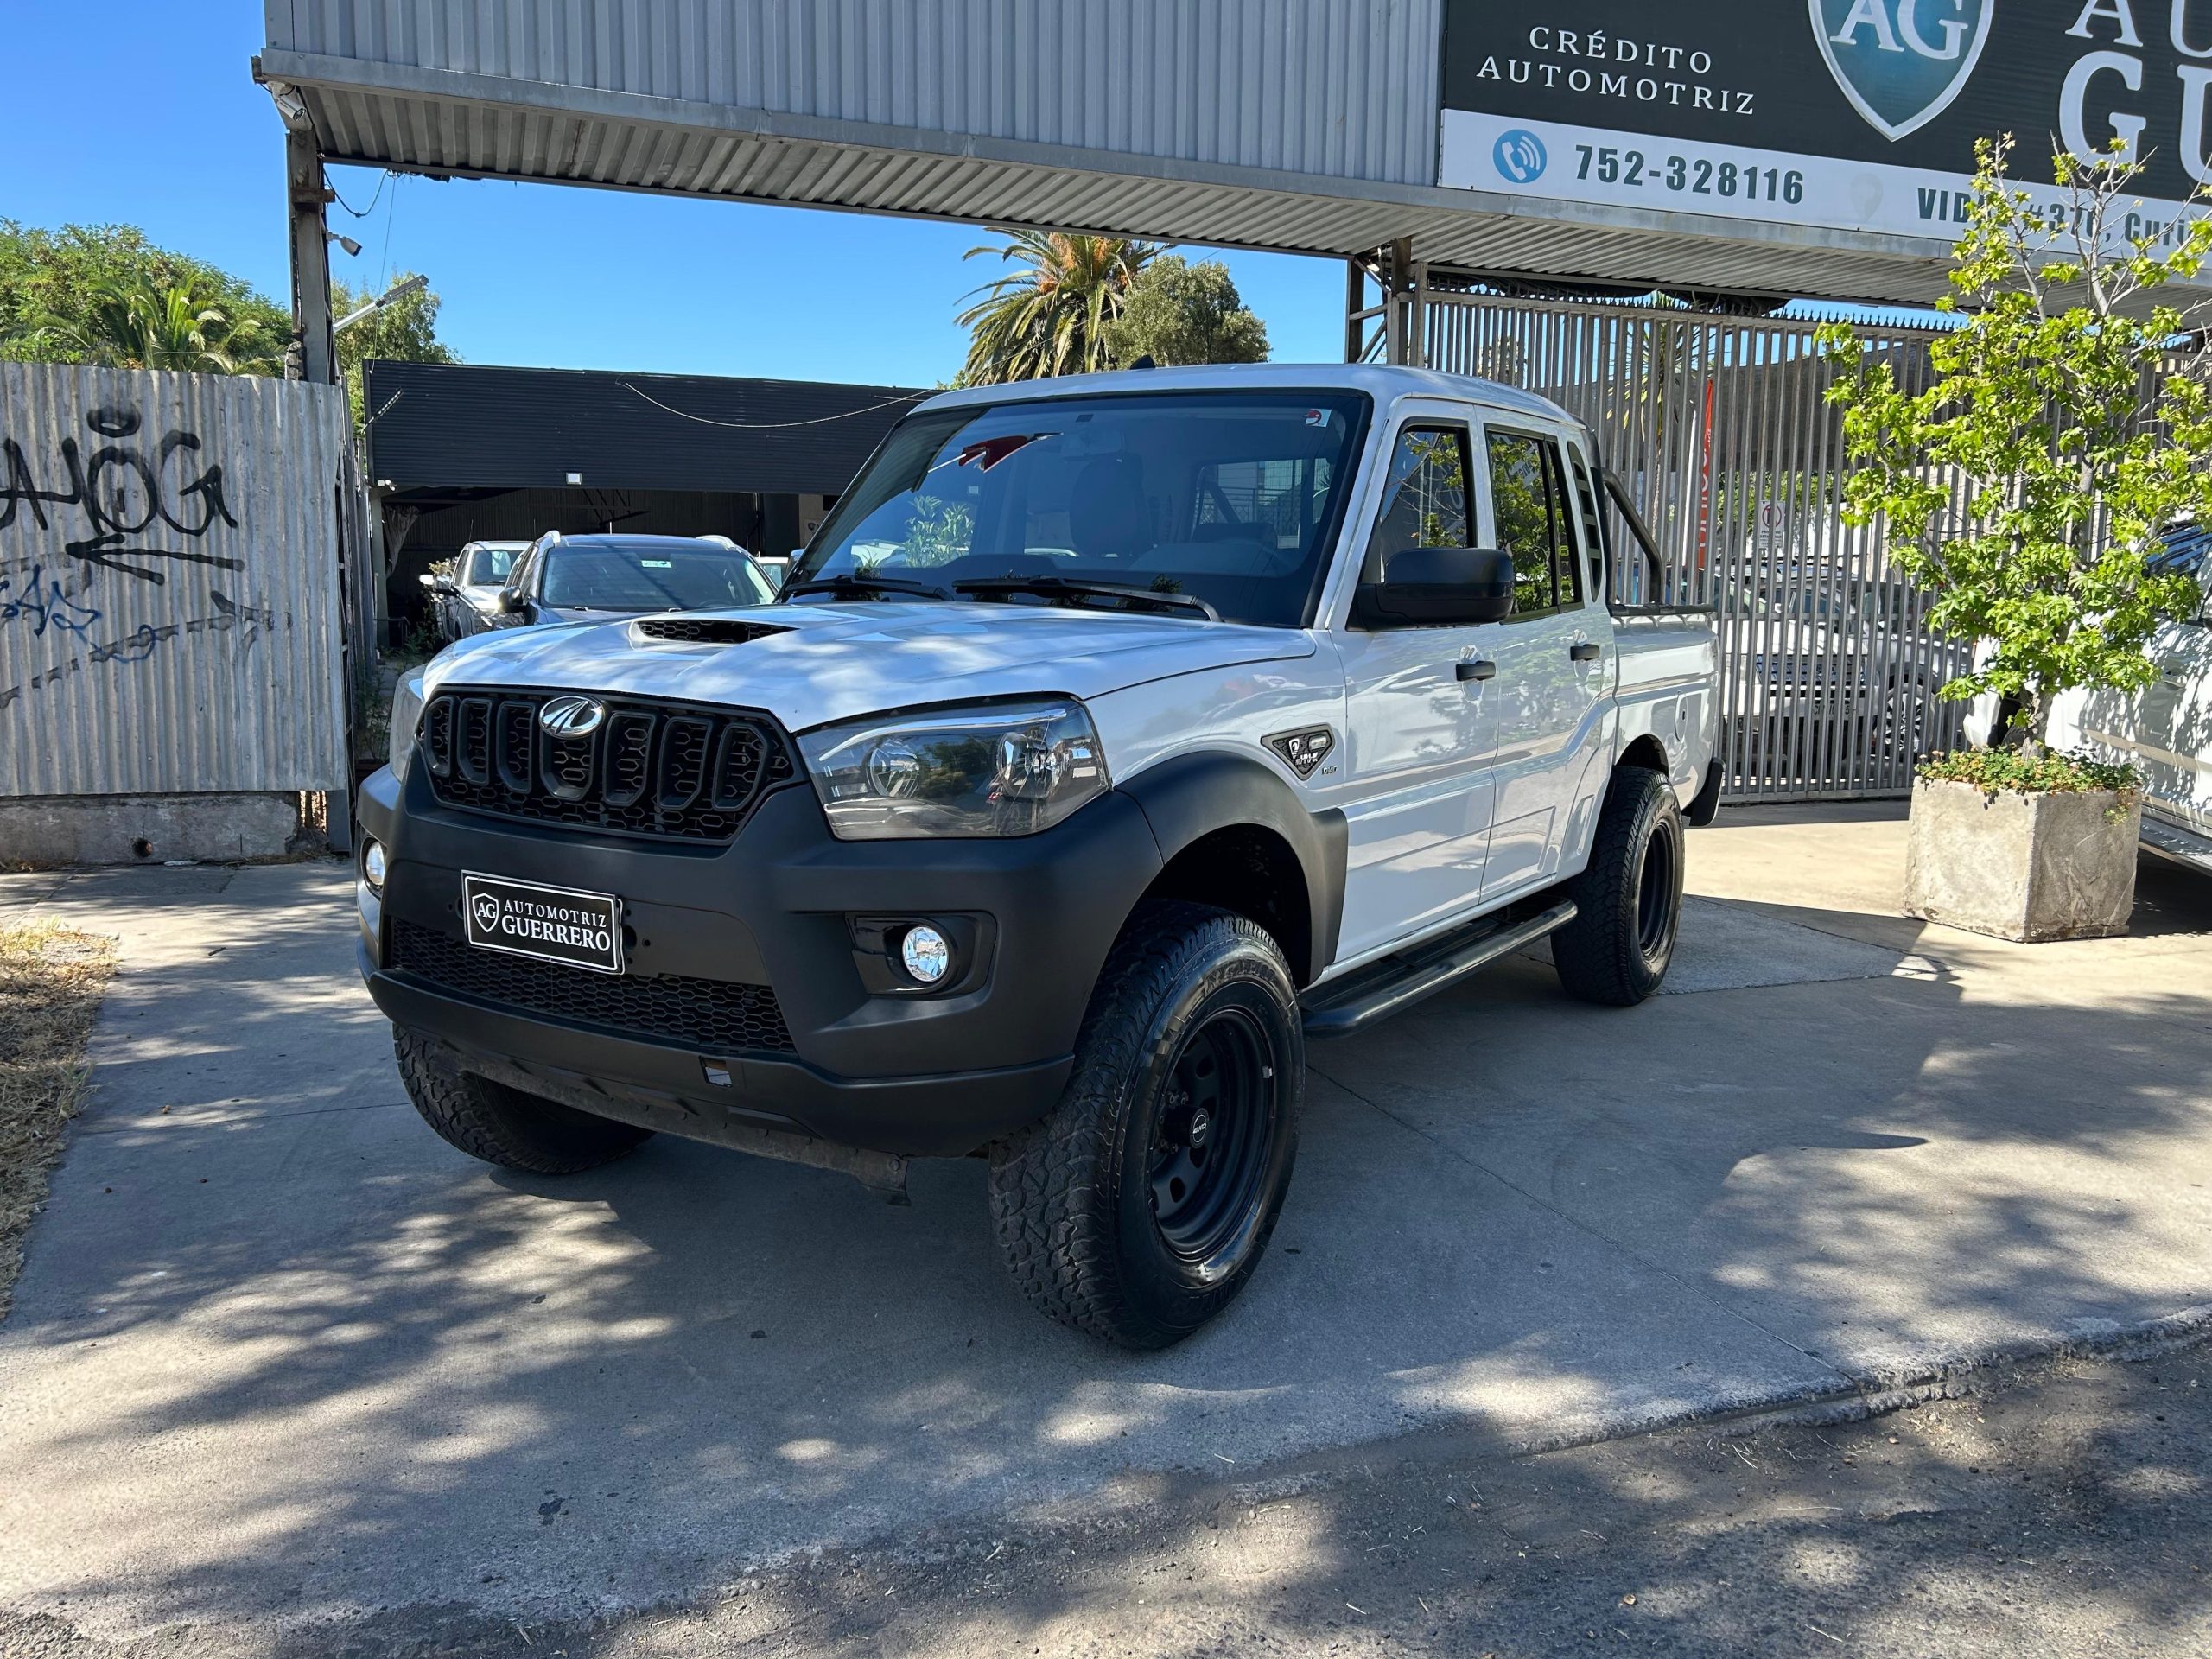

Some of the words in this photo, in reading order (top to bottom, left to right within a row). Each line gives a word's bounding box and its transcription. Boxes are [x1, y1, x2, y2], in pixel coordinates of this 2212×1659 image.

[1529, 26, 1712, 74] CRÉDITO
[1830, 0, 1968, 60] AG
[1476, 55, 1755, 115] AUTOMOTRIZ
[1574, 144, 1804, 205] 752-328116
[1916, 187, 2009, 228] VID
[477, 902, 497, 919] AG
[501, 914, 611, 951] GUERRERO
[504, 899, 607, 928] AUTOMOTRIZ
